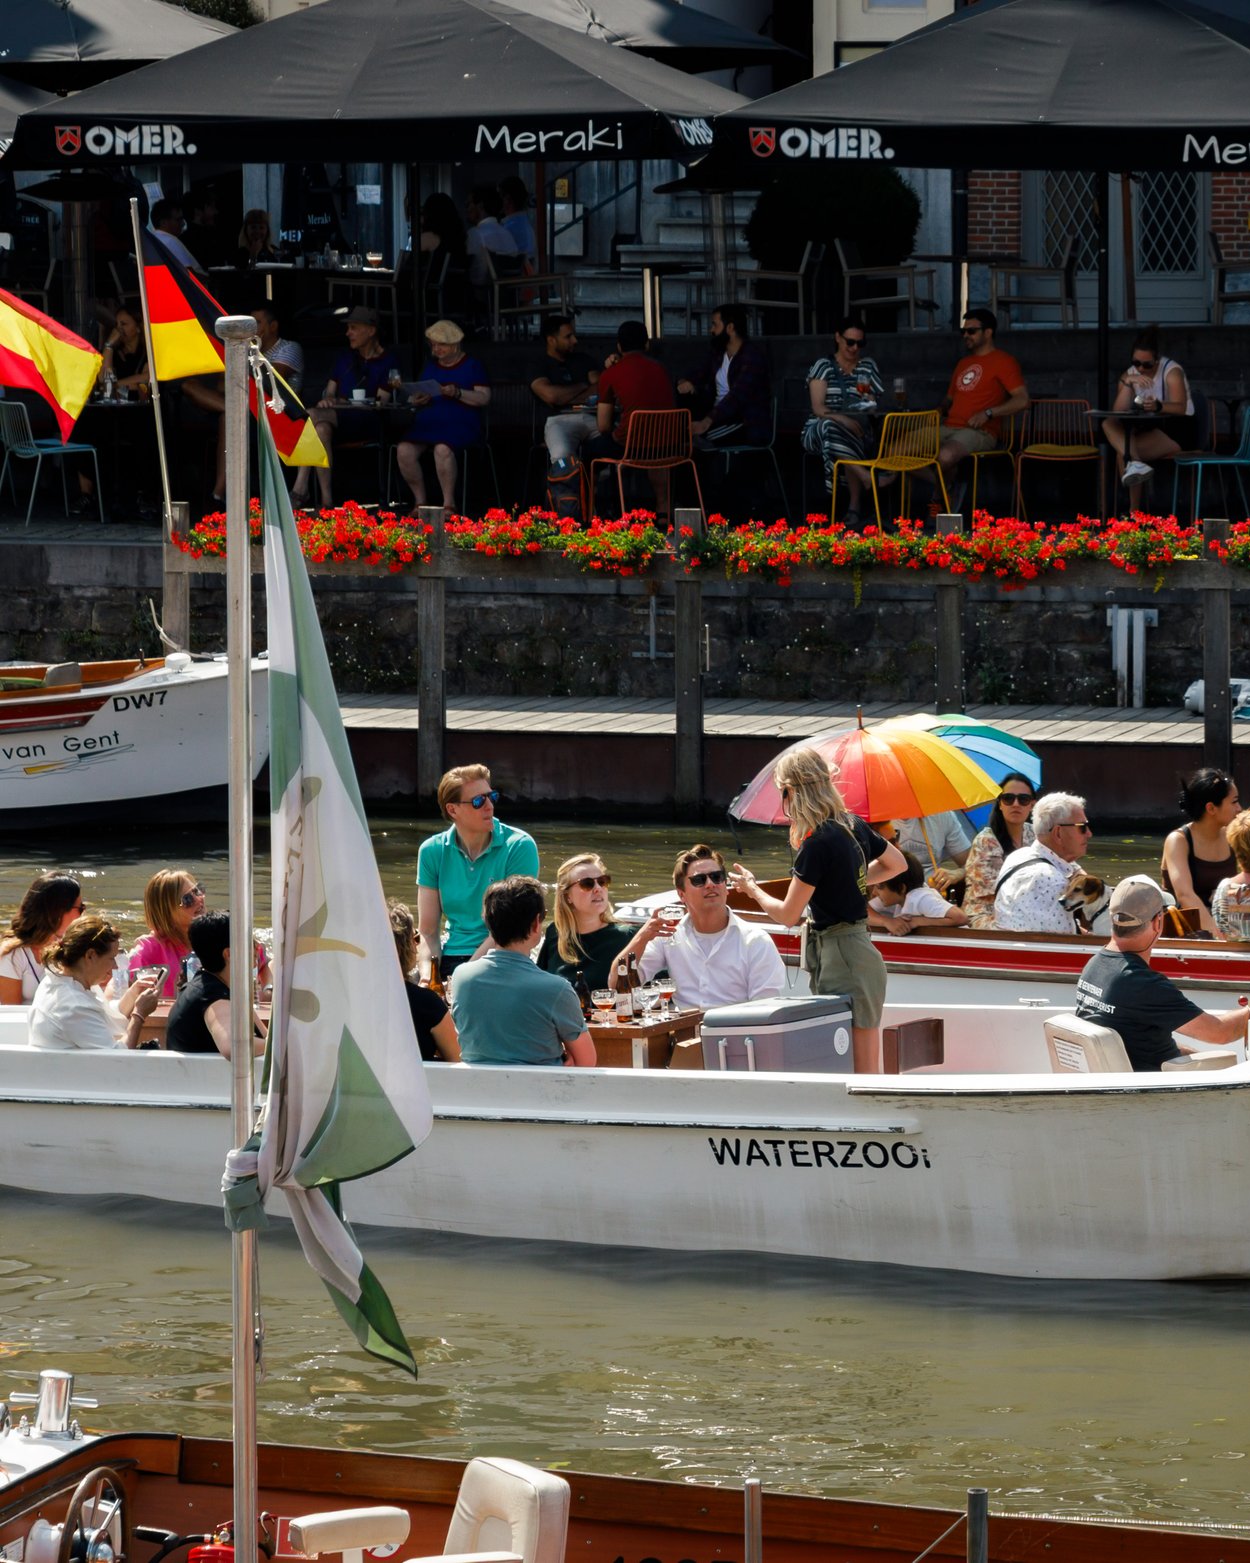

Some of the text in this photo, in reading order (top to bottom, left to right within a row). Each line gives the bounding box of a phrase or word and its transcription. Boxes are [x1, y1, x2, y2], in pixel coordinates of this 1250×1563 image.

[84, 124, 197, 156] OMER.
[475, 119, 623, 153] Meraki
[779, 127, 895, 159] OMER.
[112, 690, 168, 713] DW7
[2, 730, 120, 760] van Gent
